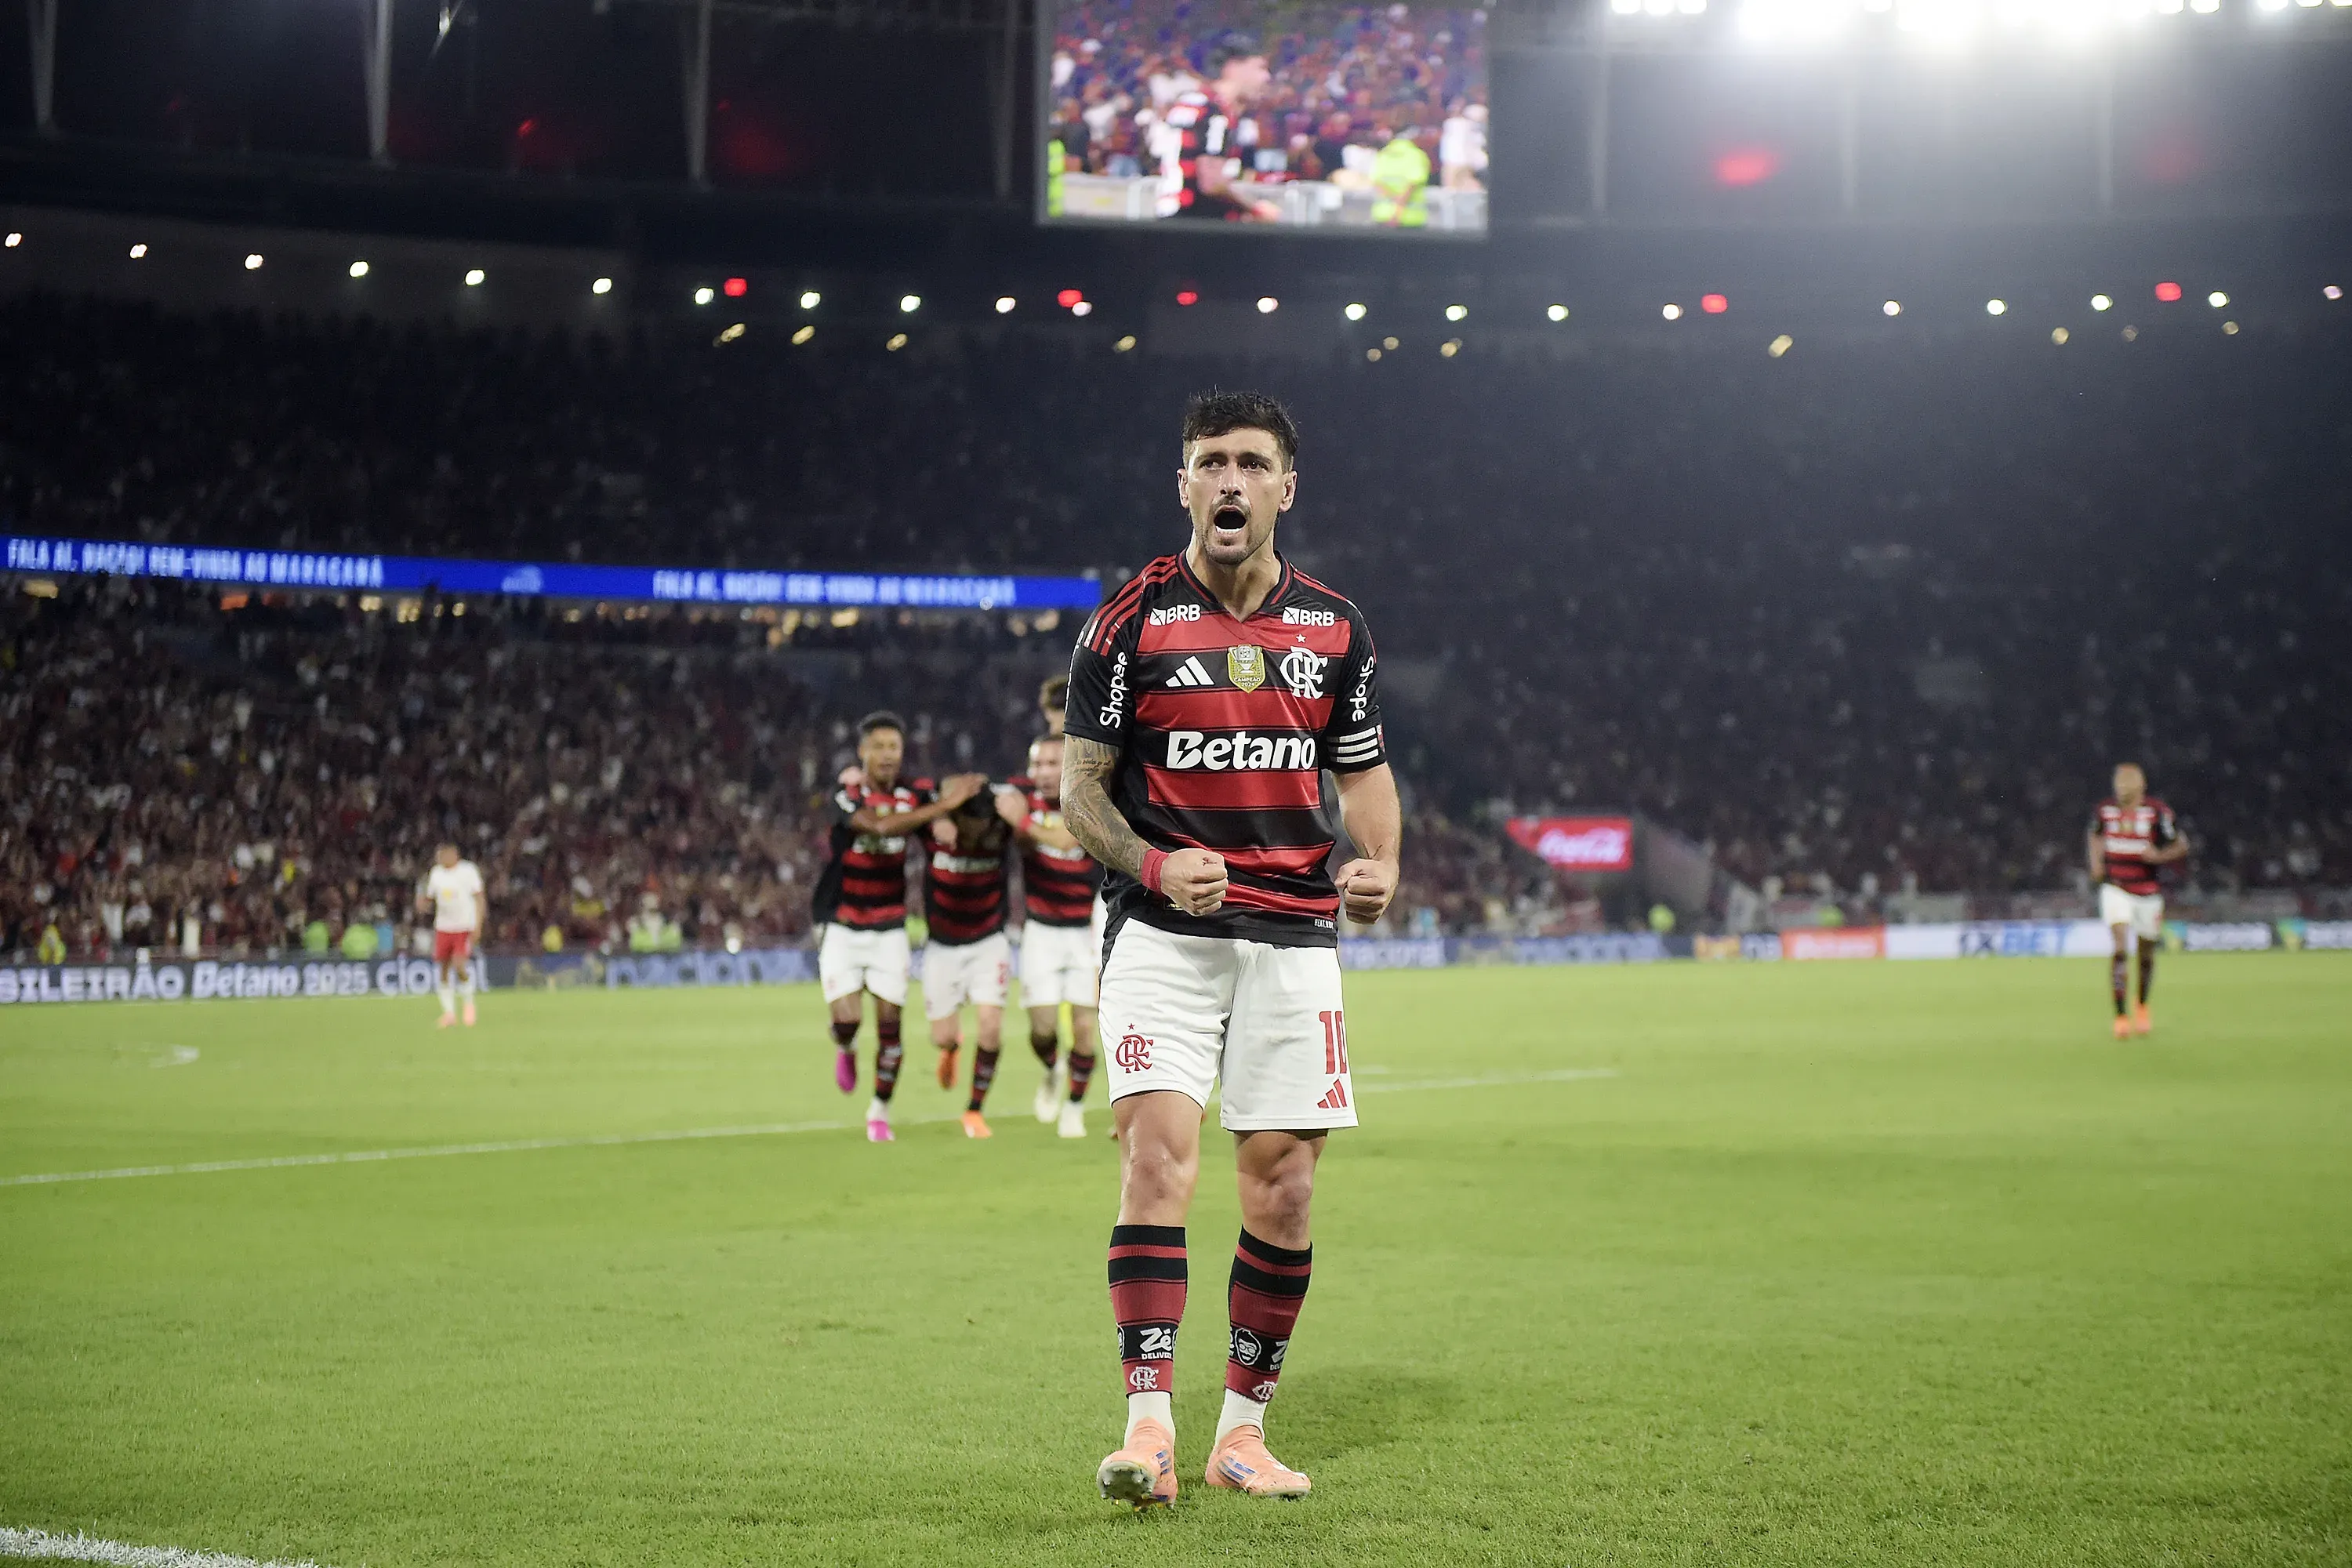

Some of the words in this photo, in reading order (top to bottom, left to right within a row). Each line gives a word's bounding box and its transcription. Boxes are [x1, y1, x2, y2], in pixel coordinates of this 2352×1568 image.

[1166, 604, 1201, 624] BRB
[1299, 610, 1335, 626] BRB
[1099, 652, 1130, 729] Shopee
[1167, 731, 1316, 771] Betano
[192, 961, 299, 999] Betano
[303, 963, 369, 996] 2025
